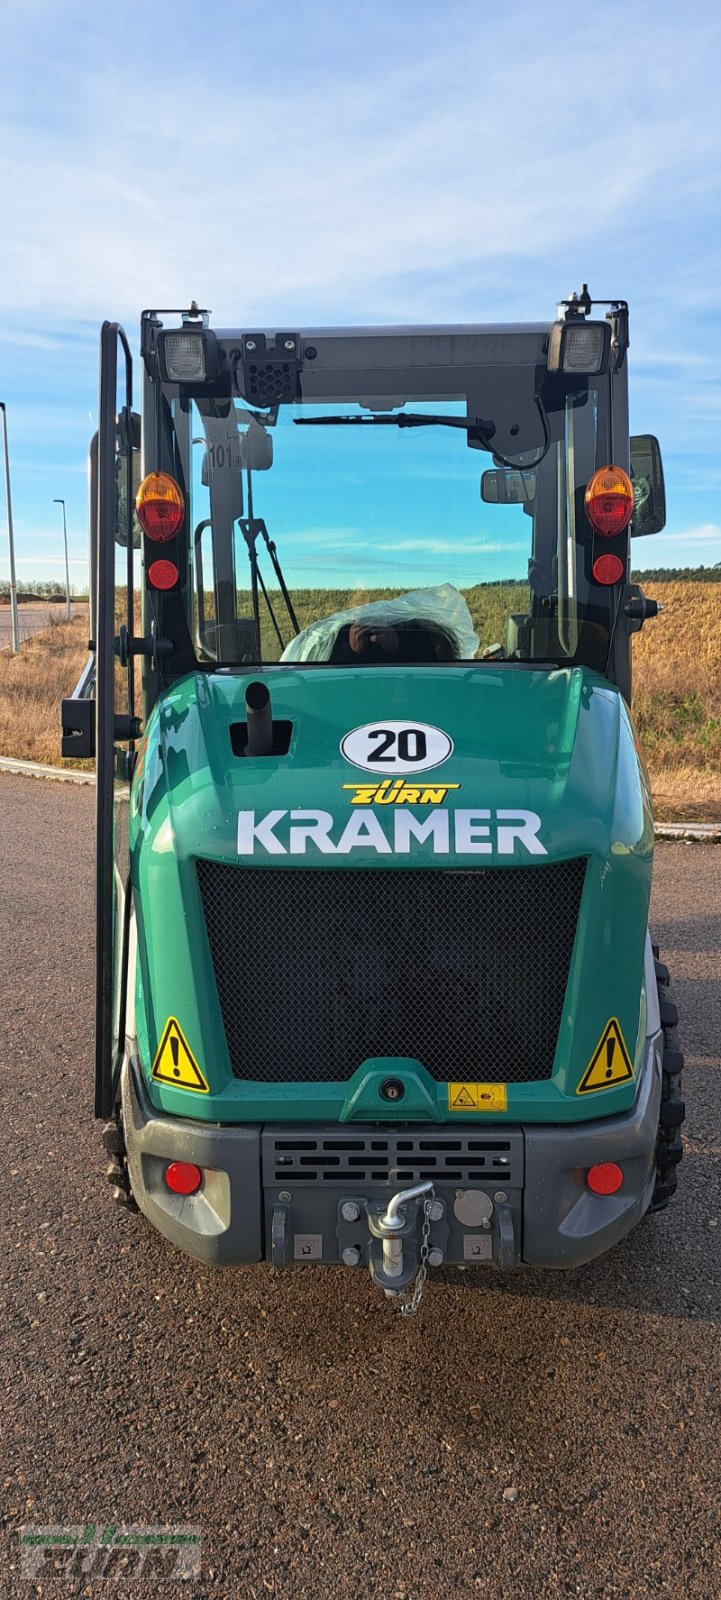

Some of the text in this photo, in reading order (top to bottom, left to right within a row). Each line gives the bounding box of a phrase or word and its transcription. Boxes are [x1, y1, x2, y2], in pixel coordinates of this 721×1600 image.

[209, 444, 231, 468] 101
[366, 728, 427, 763] 20
[349, 779, 449, 805] ZÜRN
[236, 808, 549, 856] KRAMER
